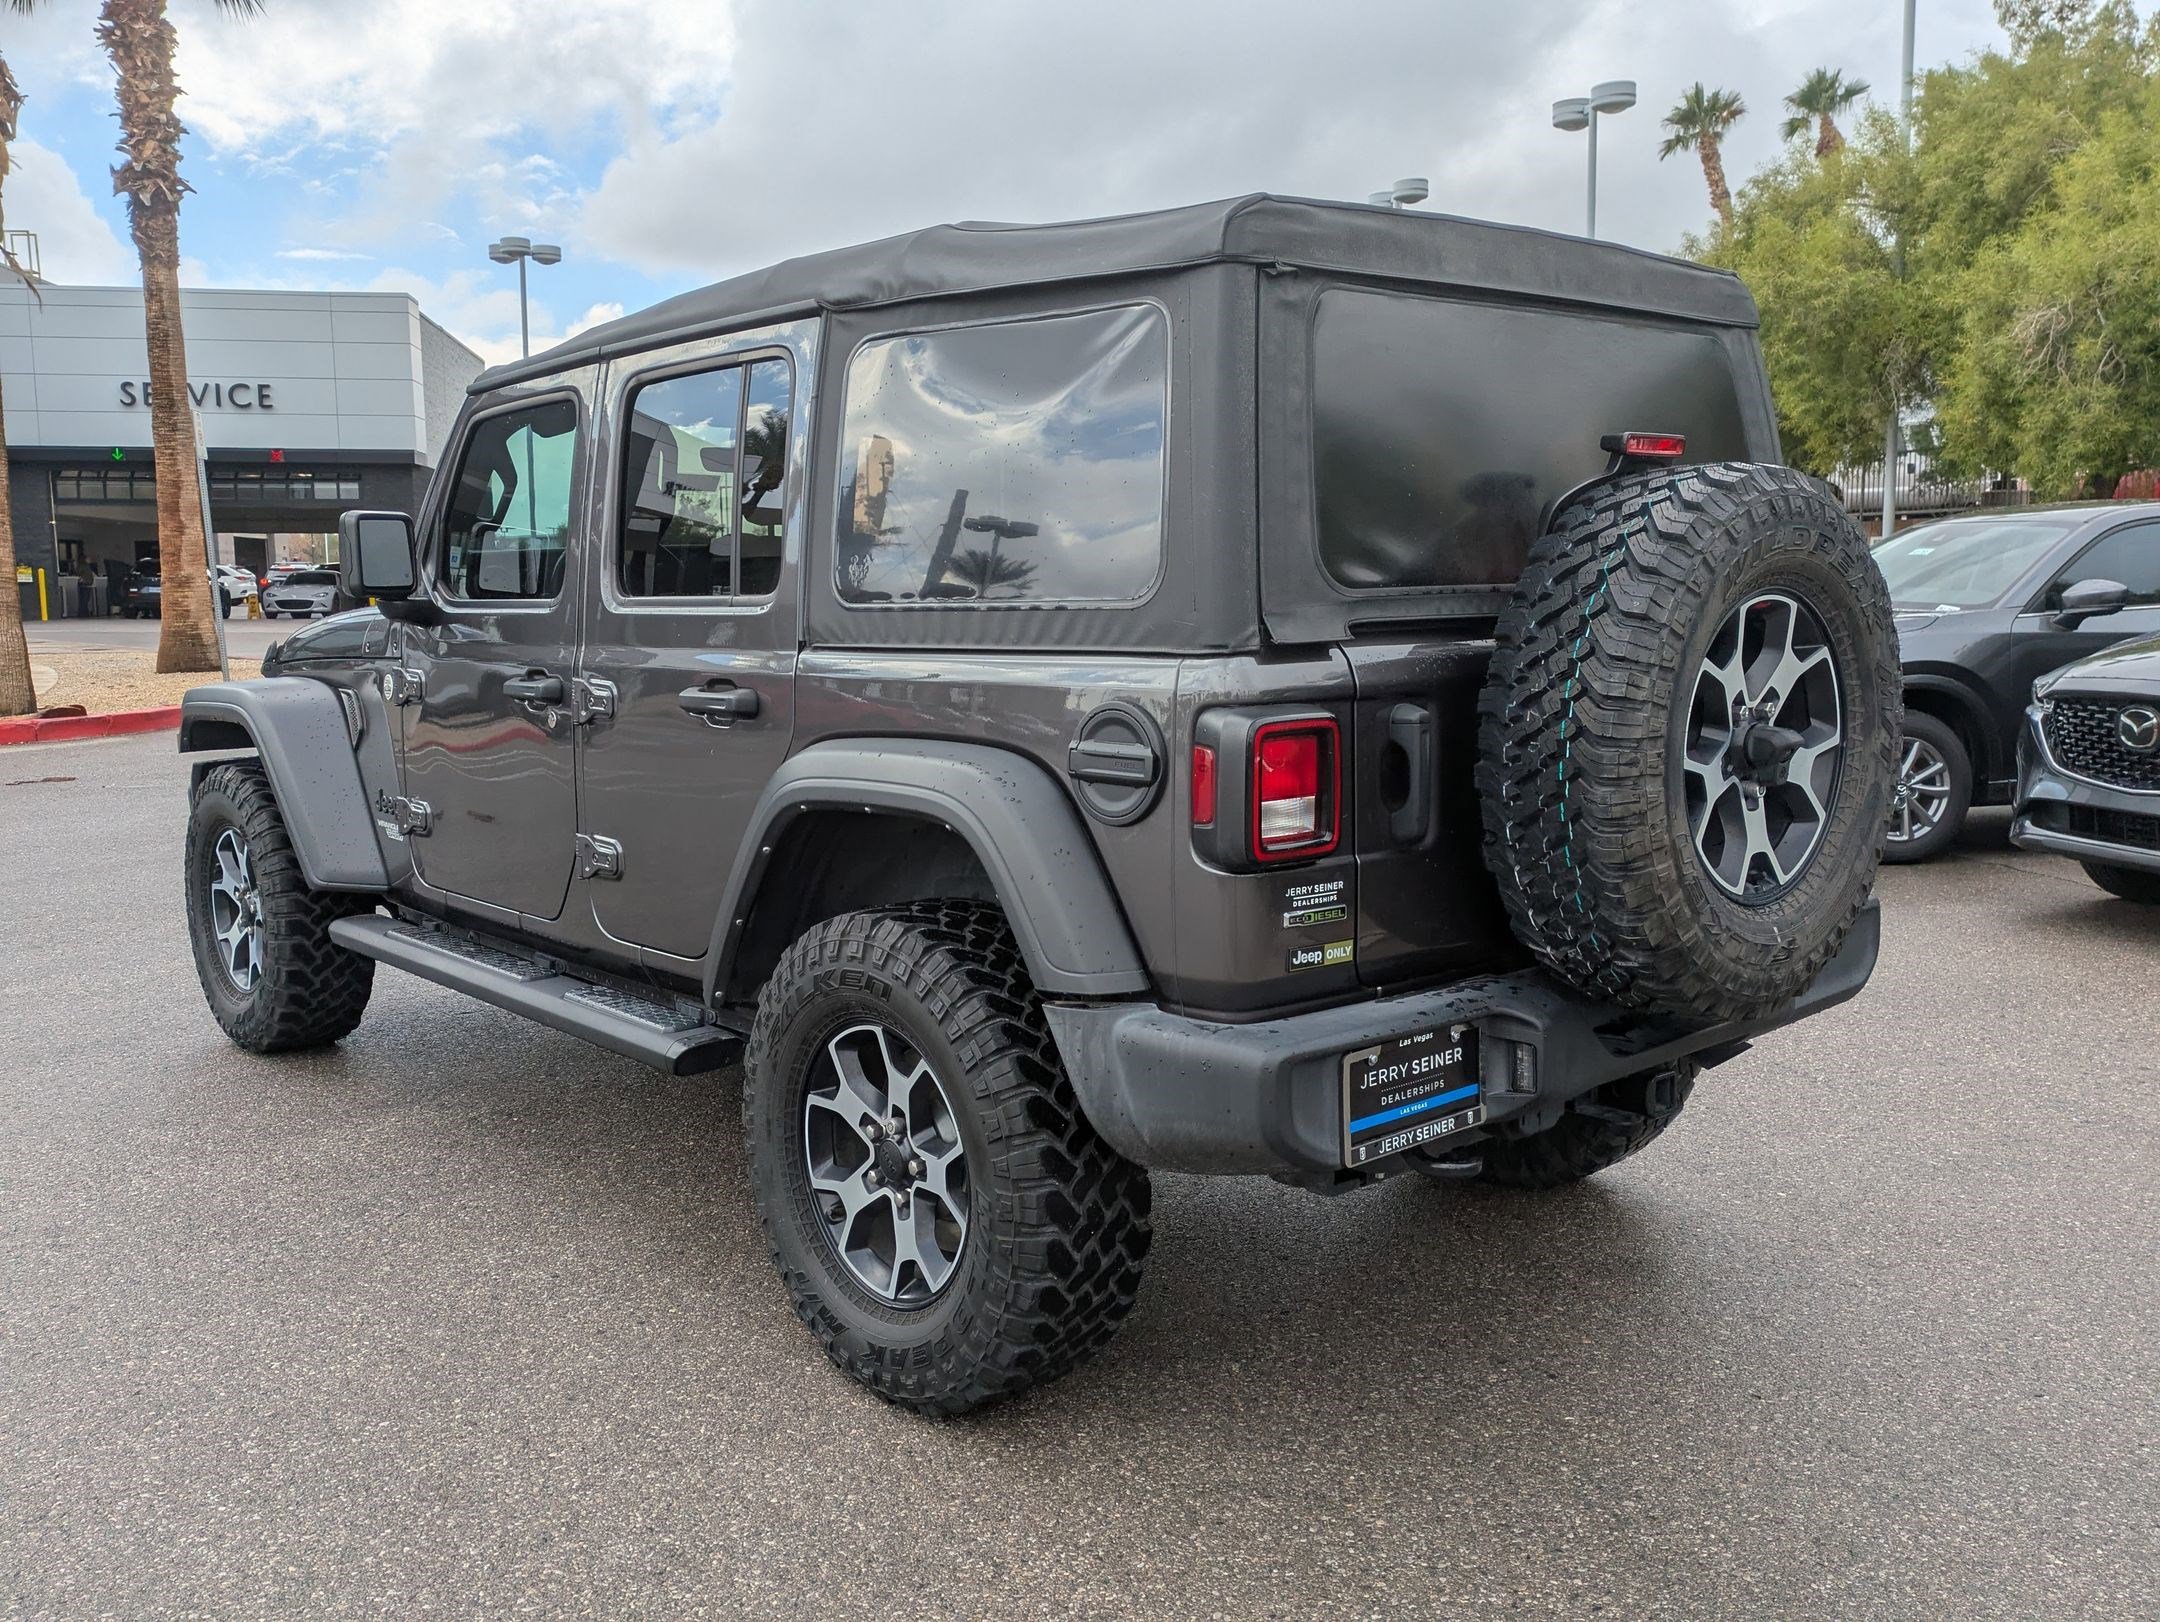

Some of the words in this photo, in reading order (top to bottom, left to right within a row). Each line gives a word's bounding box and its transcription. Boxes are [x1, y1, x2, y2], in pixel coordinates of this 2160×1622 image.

[119, 381, 274, 409] SEVICE
[1114, 760, 1138, 770] FUEL
[1285, 886, 1313, 897] JERRY
[1314, 881, 1344, 892] SEINER
[1293, 894, 1338, 907] DEALERSHIPS
[1292, 950, 1322, 965] Jeep
[1326, 945, 1352, 959] ONLY
[1399, 1036, 1411, 1047] Las
[1414, 1032, 1434, 1043] Vegas
[1360, 1062, 1409, 1089] JERRY
[1412, 1047, 1463, 1074] SEINER
[1381, 1079, 1445, 1105] DEALERSHIPS
[1400, 1107, 1411, 1115] LAS
[1411, 1102, 1428, 1112] VEGAS
[1379, 1131, 1414, 1154] JERRY
[1416, 1117, 1456, 1141] SEINER
